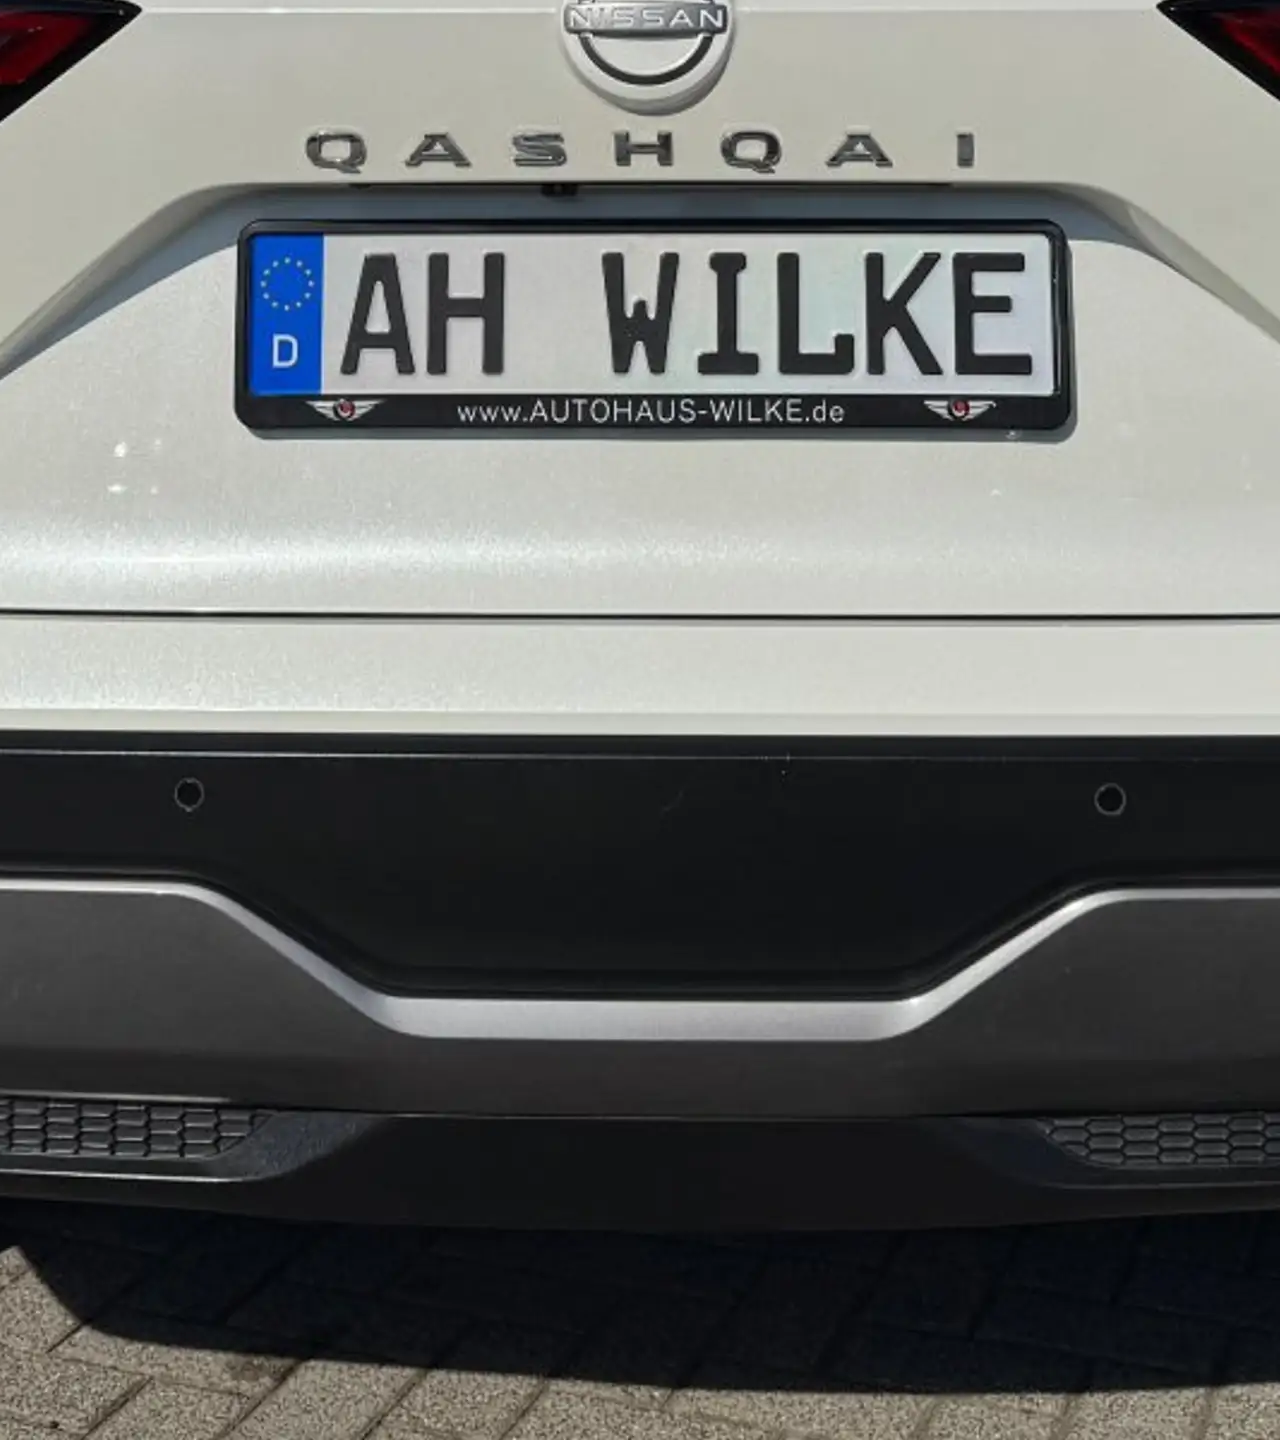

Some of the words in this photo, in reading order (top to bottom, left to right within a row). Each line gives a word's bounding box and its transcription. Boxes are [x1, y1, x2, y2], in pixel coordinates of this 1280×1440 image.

[569, 7, 724, 29] NISSAN
[305, 131, 974, 174] QASHQAI
[339, 252, 505, 376] AH
[601, 252, 1033, 376] WILKE
[271, 336, 298, 369] D
[457, 398, 845, 424] www.AUTOHAUS-WILKE.de
